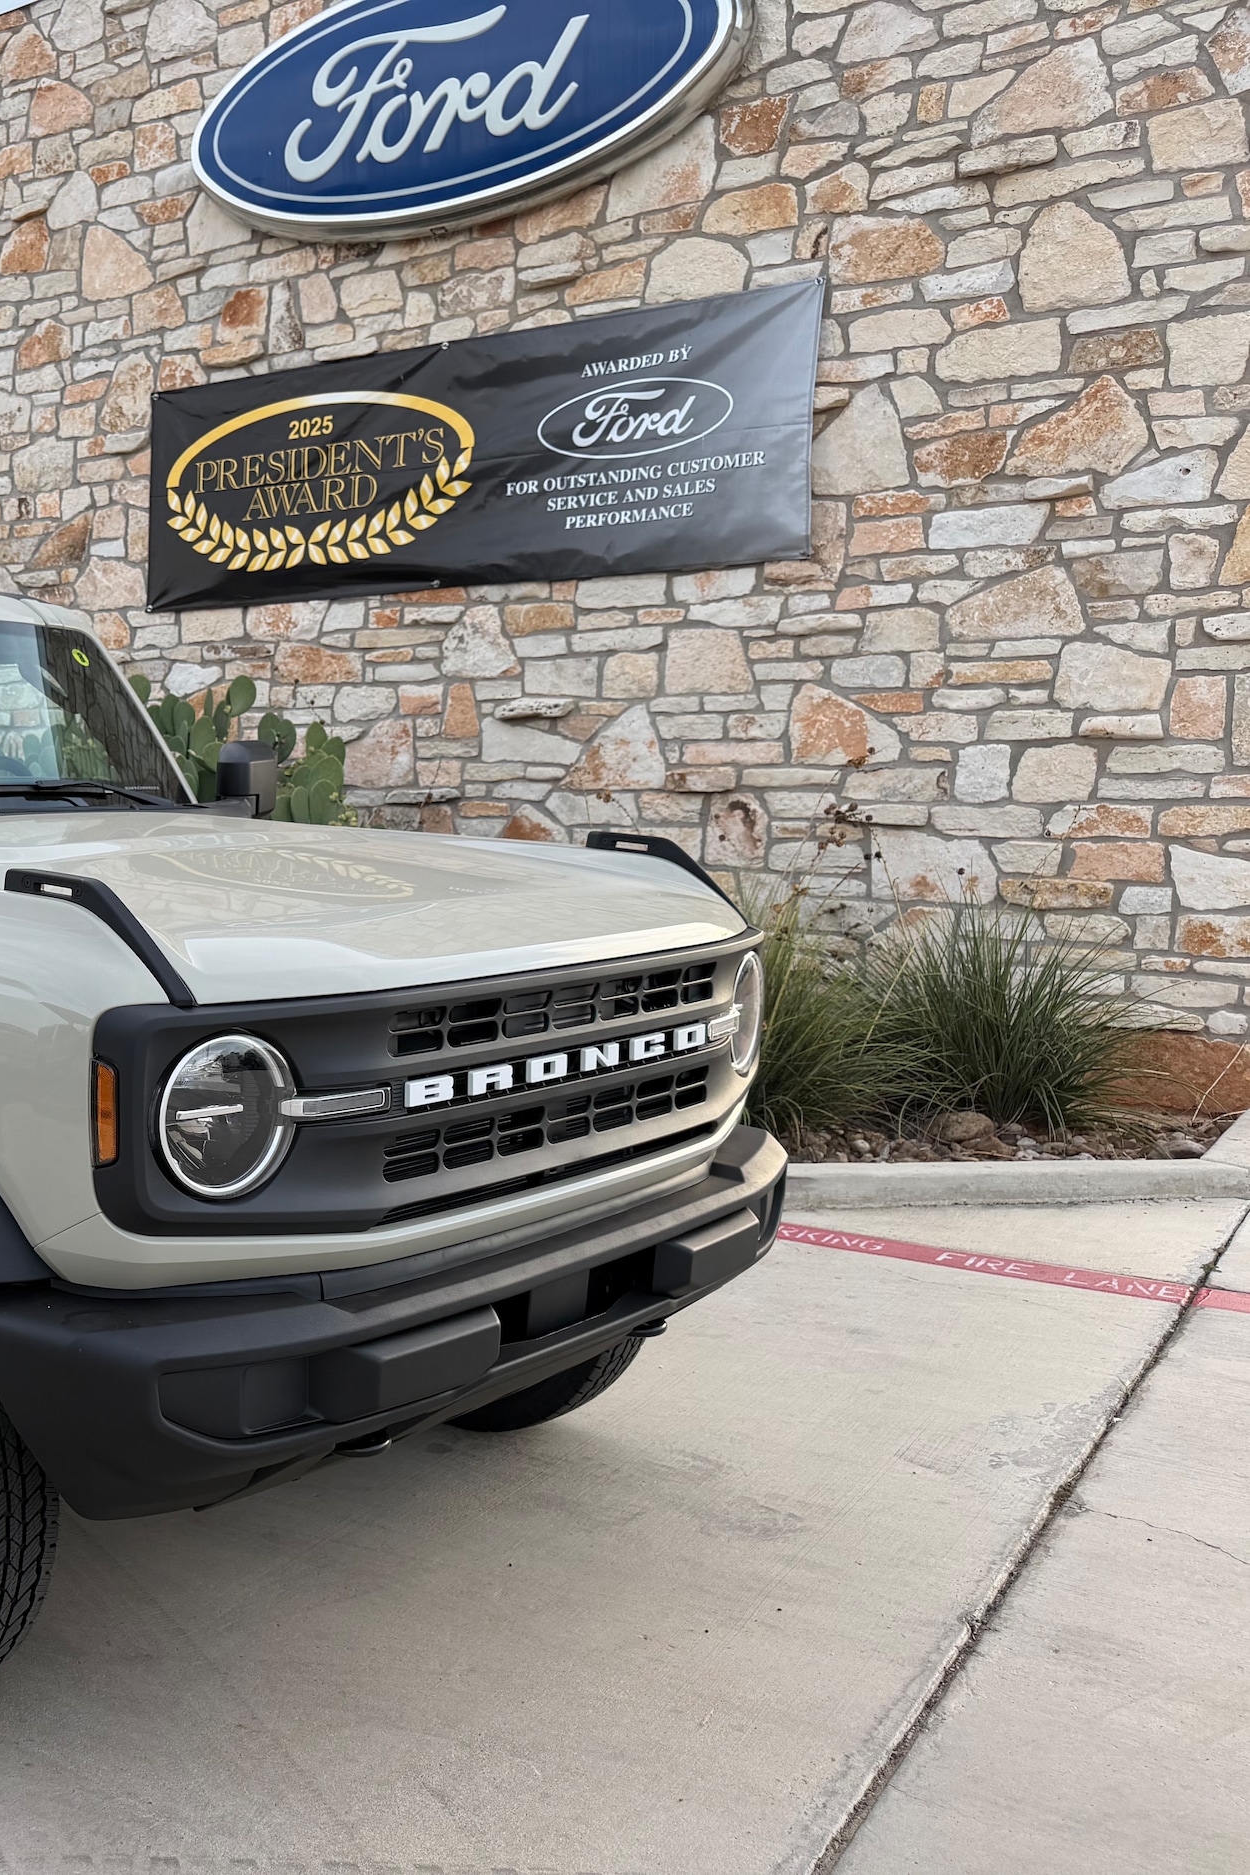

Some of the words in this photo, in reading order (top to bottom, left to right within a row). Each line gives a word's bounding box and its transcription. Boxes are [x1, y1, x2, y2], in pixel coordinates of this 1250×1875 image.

[284, 4, 590, 182] Ford
[581, 351, 664, 378] AWARDED
[667, 345, 692, 363] BY
[288, 415, 334, 440] 2025
[572, 388, 696, 447] Ford
[194, 427, 445, 494] PRESIDENT'S
[506, 481, 539, 496] FOR
[543, 465, 662, 492] OUTSTANDING
[667, 450, 765, 477] CUSTOMER
[241, 473, 378, 522] AWARD
[546, 491, 618, 512] SERVICE
[623, 485, 659, 503] AND
[662, 478, 716, 499] SALES
[564, 502, 694, 530] PERFORMANCE
[404, 1022, 706, 1108] BRONCO
[935, 1251, 1035, 1276] FIRE
[1063, 1271, 1184, 1300] LANE
